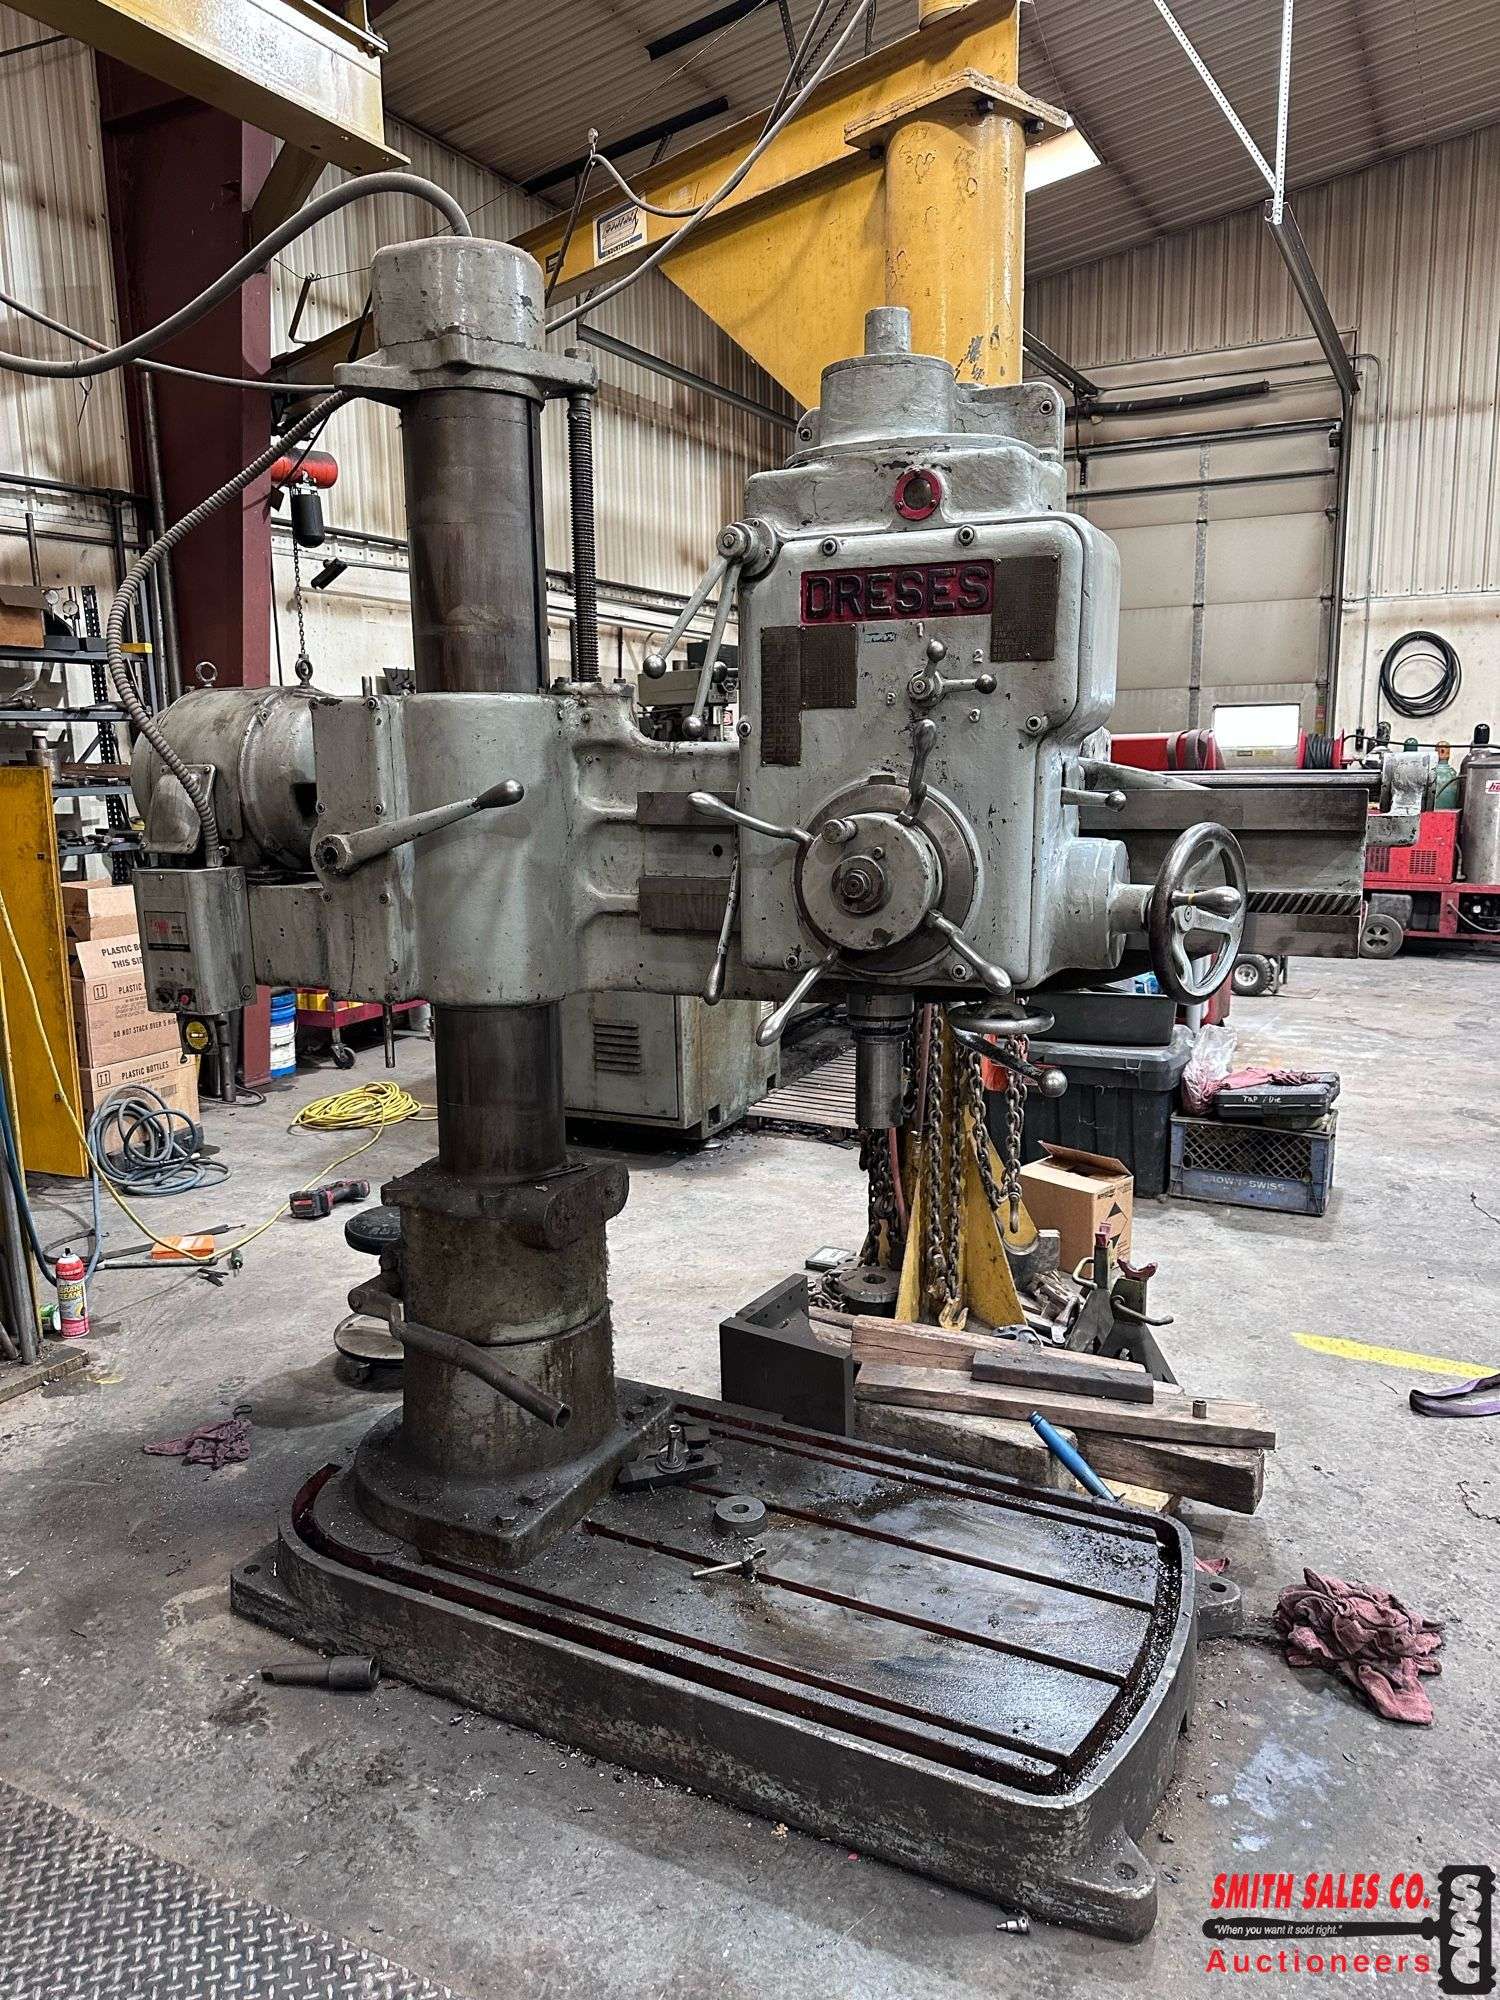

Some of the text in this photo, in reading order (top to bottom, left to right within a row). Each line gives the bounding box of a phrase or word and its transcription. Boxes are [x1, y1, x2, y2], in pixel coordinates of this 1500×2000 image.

[807, 566, 990, 619] DRESES
[101, 944, 132, 957] PLASTIC
[112, 958, 131, 968] THIS
[118, 983, 142, 994] PLASTIC
[133, 1024, 148, 1034] STACK
[121, 1067, 145, 1080] PLASTIC
[146, 1060, 169, 1074] BOTTLES
